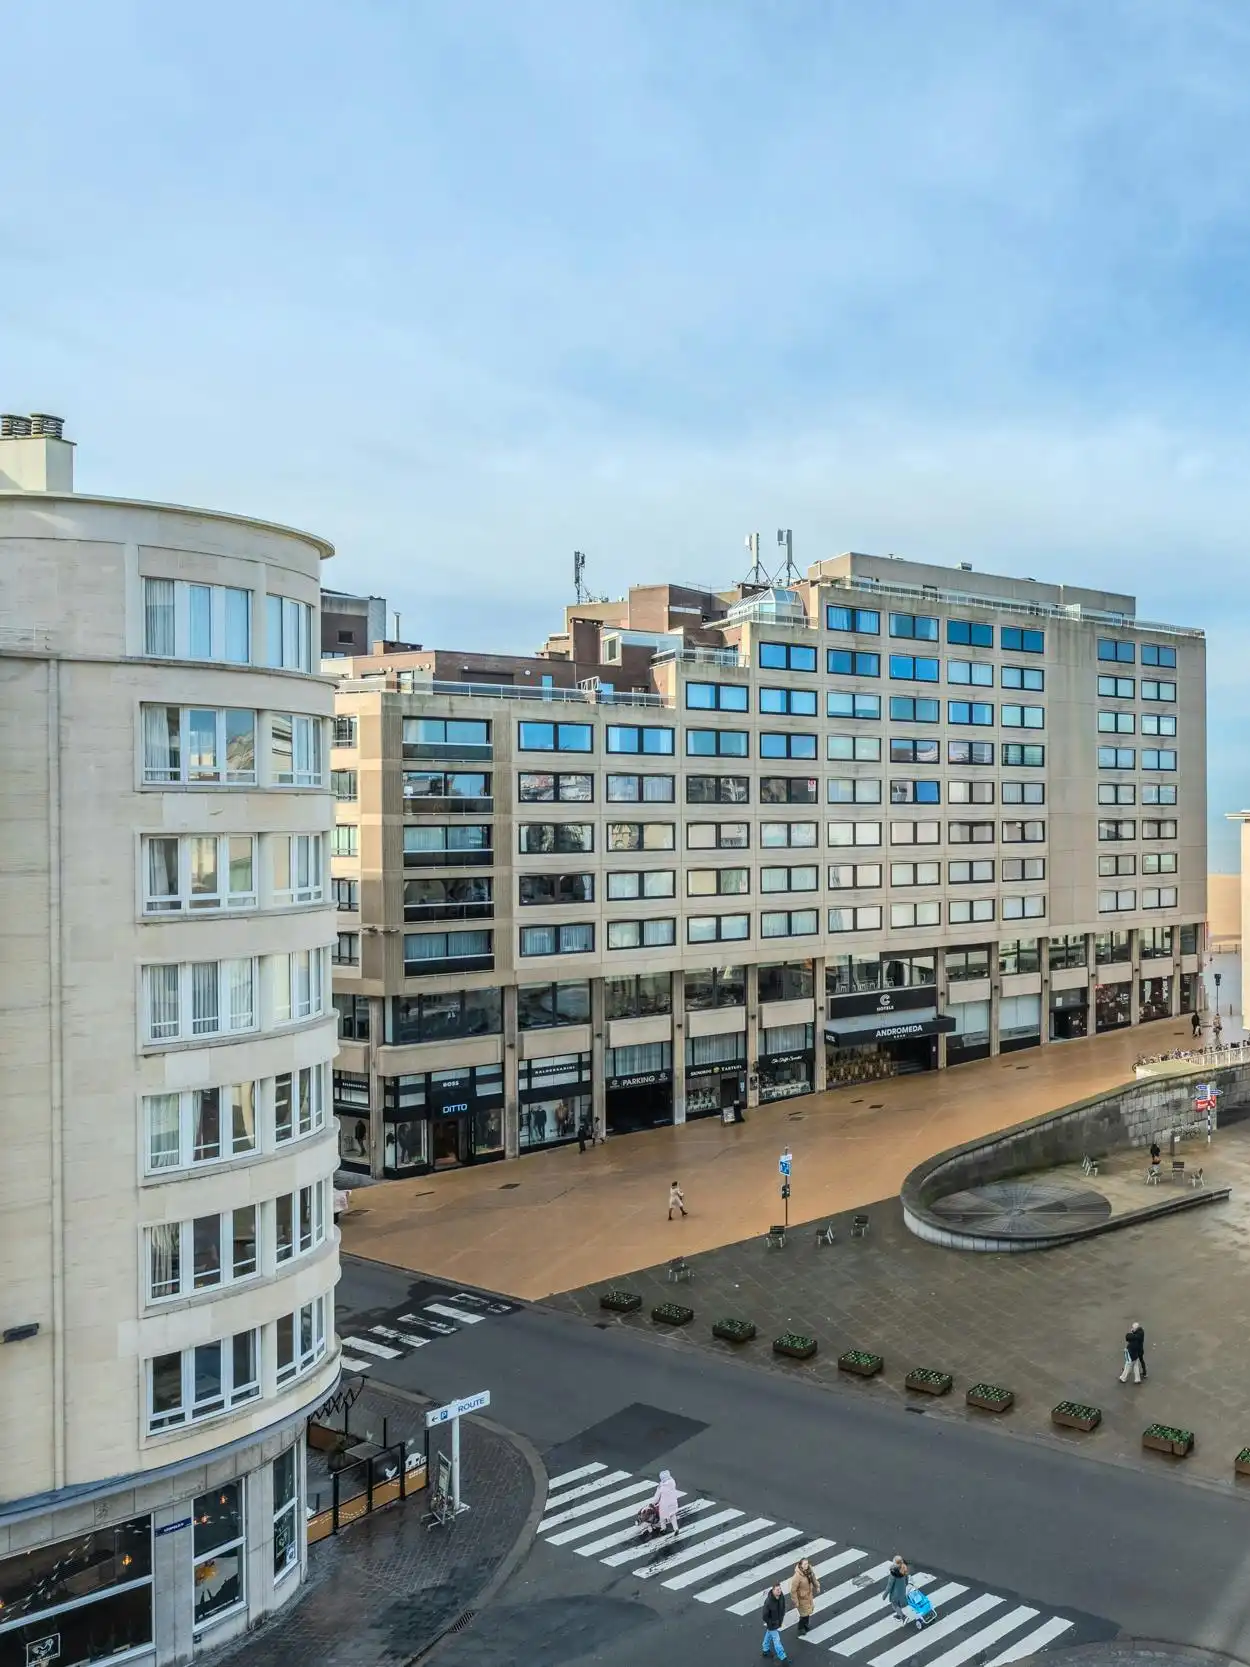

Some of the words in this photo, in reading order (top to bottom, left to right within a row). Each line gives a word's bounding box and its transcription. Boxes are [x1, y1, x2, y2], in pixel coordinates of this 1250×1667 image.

[875, 1024, 923, 1038] ANDROMEDA
[442, 1080, 460, 1088] BOSS
[622, 1075, 656, 1087] PARKING
[442, 1103, 468, 1114] DITTO
[458, 1397, 486, 1412] ROUTE
